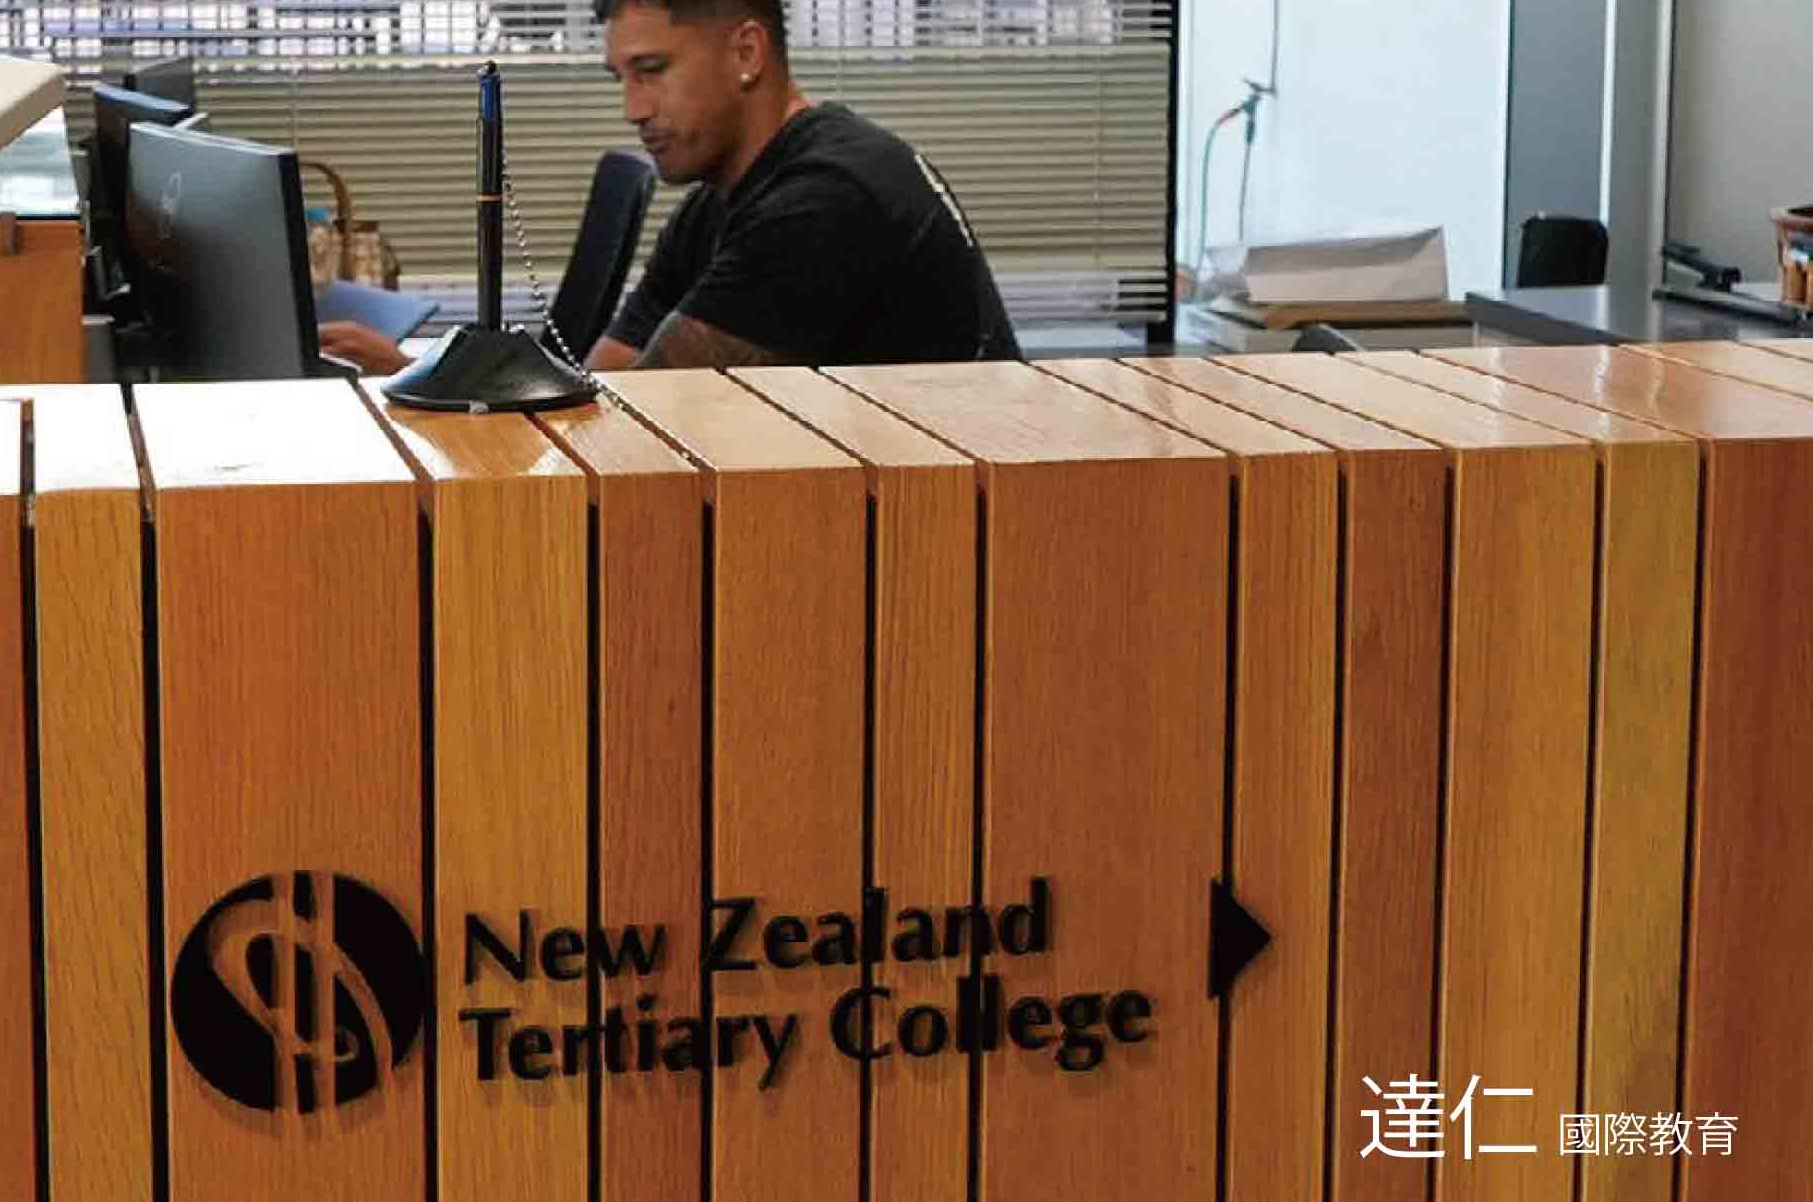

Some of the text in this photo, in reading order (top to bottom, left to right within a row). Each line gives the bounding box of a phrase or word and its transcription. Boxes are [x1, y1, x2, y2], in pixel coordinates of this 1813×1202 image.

[464, 876, 1052, 985] New Zealand
[458, 973, 1153, 1091] Tertiary College
